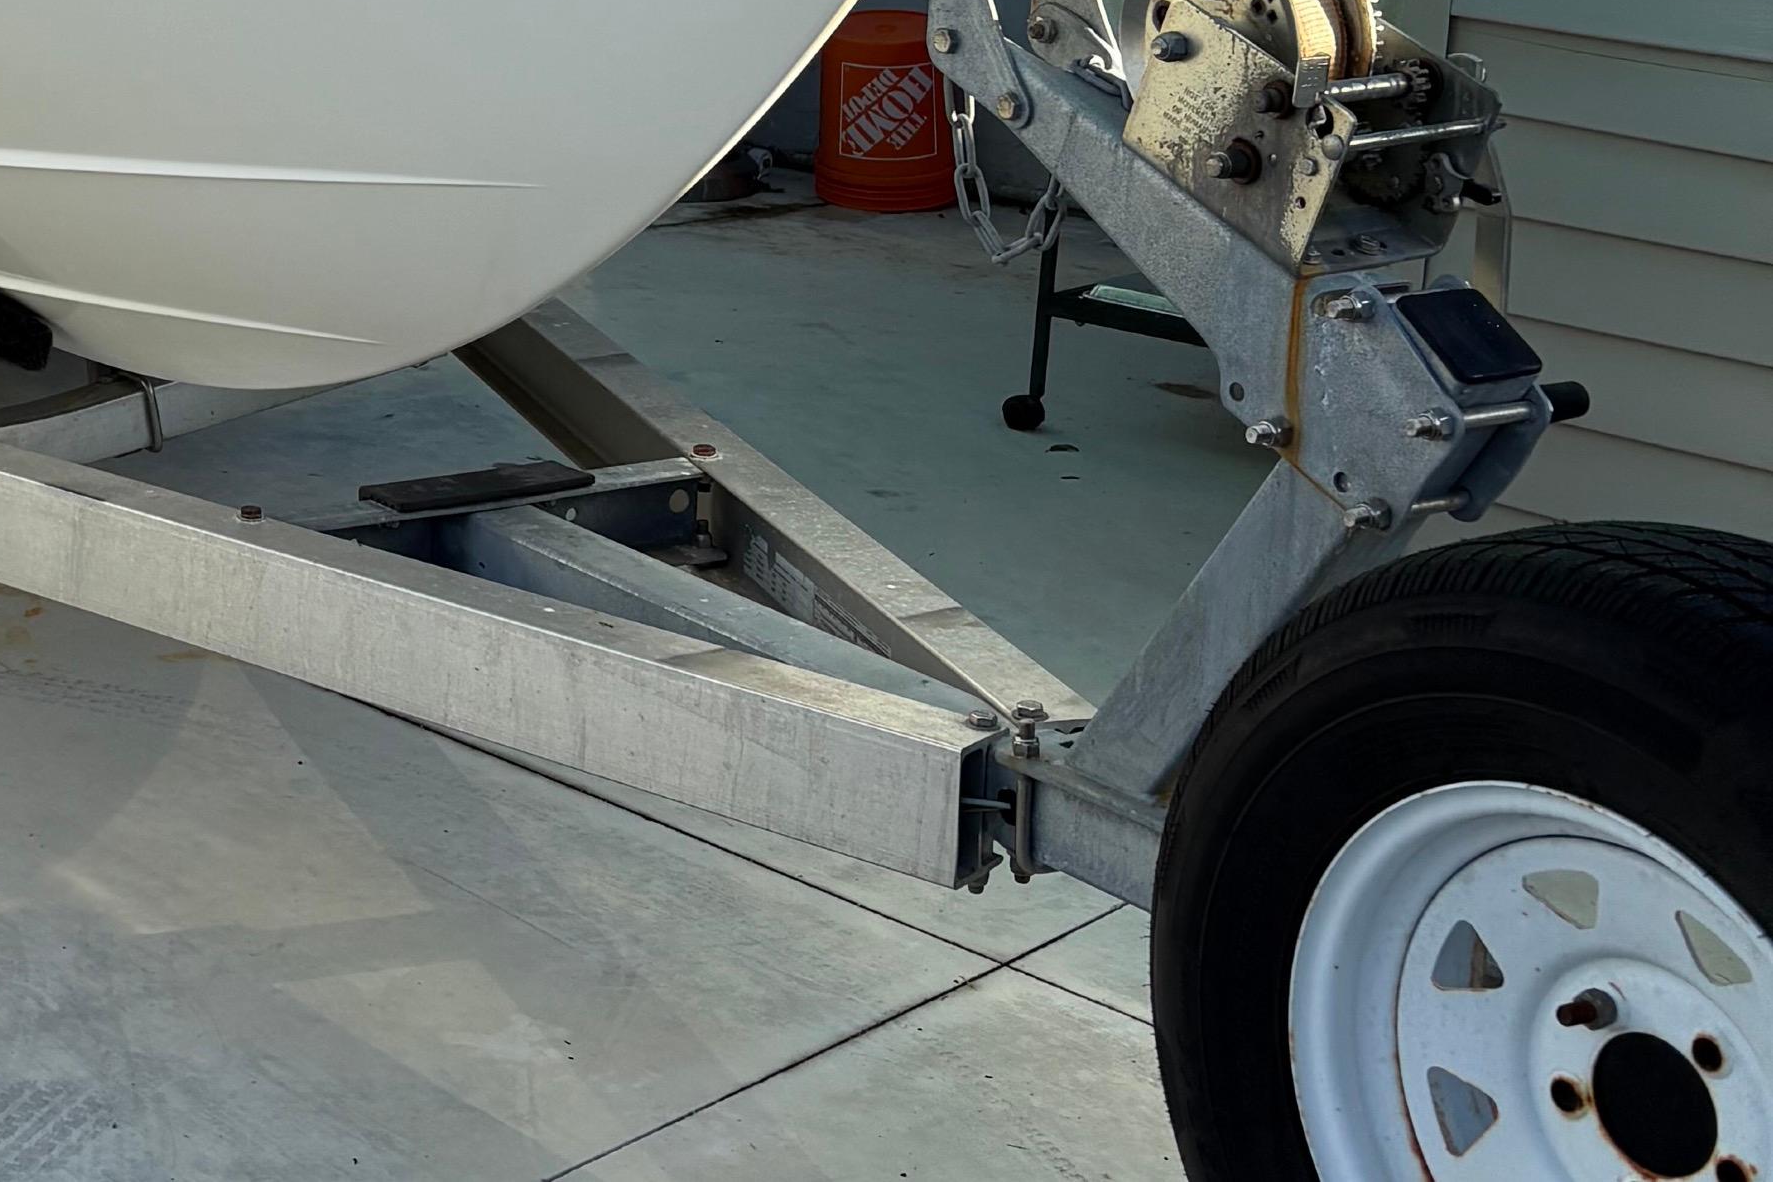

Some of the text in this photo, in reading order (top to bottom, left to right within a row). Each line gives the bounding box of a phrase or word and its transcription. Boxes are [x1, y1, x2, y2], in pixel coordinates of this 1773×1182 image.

[841, 67, 900, 122] DEPOT
[842, 65, 934, 157] HOME
[886, 111, 928, 151] THE
